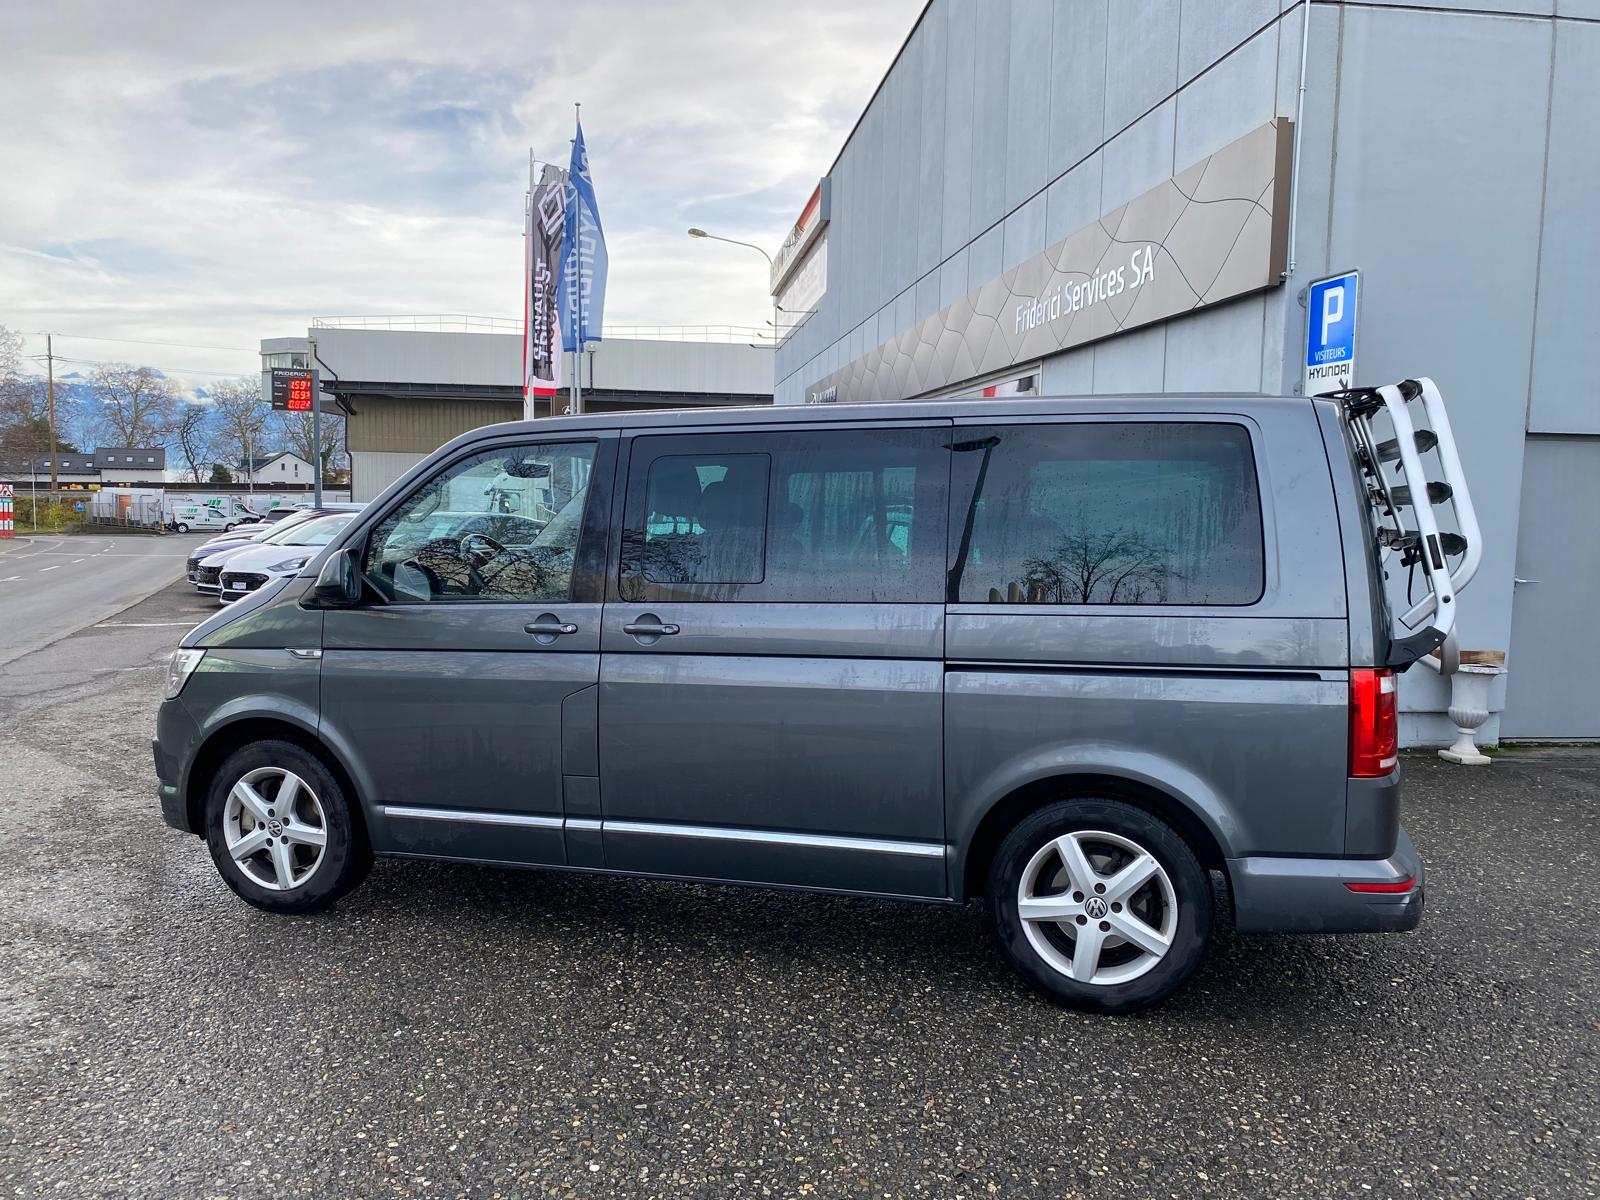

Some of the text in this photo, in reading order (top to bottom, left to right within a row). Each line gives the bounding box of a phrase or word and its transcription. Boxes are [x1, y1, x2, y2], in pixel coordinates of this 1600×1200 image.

[1015, 245, 1155, 335] Friderici Services SA
[1321, 286, 1345, 346] P
[1308, 363, 1350, 380] HYUNDAI
[1314, 346, 1346, 362] VISITEURS
